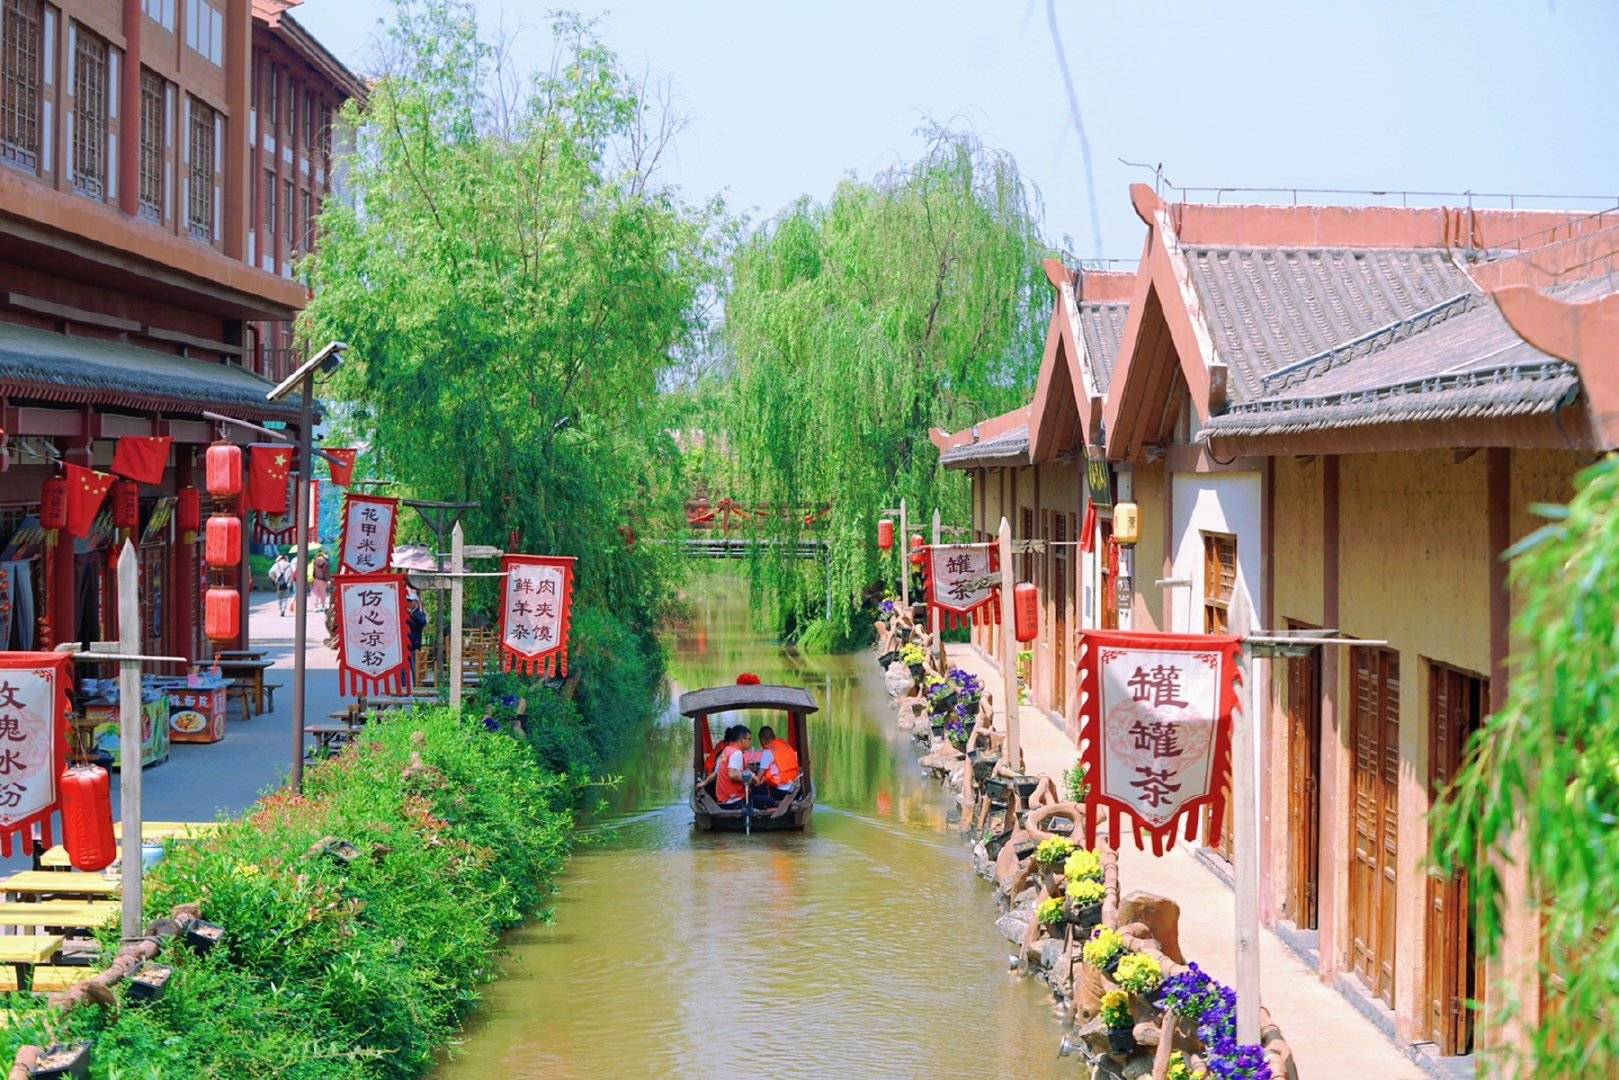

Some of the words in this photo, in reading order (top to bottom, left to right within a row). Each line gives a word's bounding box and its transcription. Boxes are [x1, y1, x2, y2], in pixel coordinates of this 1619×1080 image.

[356, 508, 379, 568] 花甲米线
[357, 590, 386, 667] 伤心凉粉
[511, 578, 534, 640] 鲜羊杂
[532, 579, 555, 641] 肉夹馍
[1127, 664, 1189, 808] 罐罐茶
